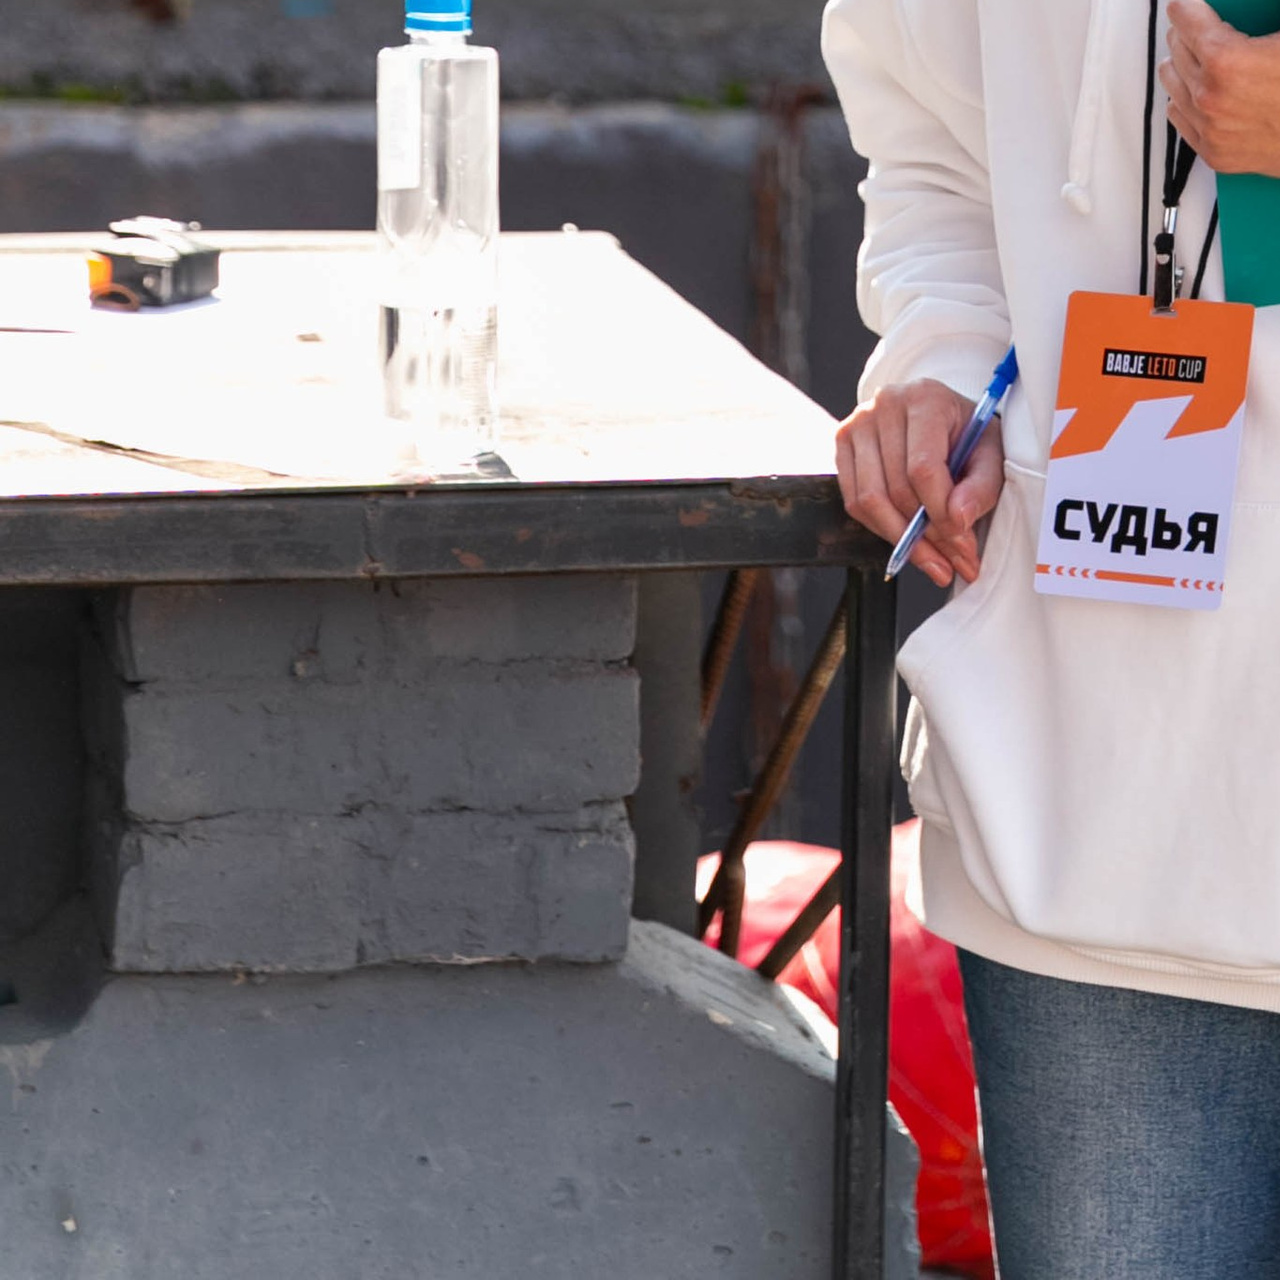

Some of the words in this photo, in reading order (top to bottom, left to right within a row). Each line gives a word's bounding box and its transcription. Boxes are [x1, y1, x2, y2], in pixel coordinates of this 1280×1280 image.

[1106, 353, 1145, 374] BABJE
[1147, 356, 1176, 377] LETO
[1178, 358, 1202, 379] CUP
[1053, 498, 1219, 556] СУДЬЯ
